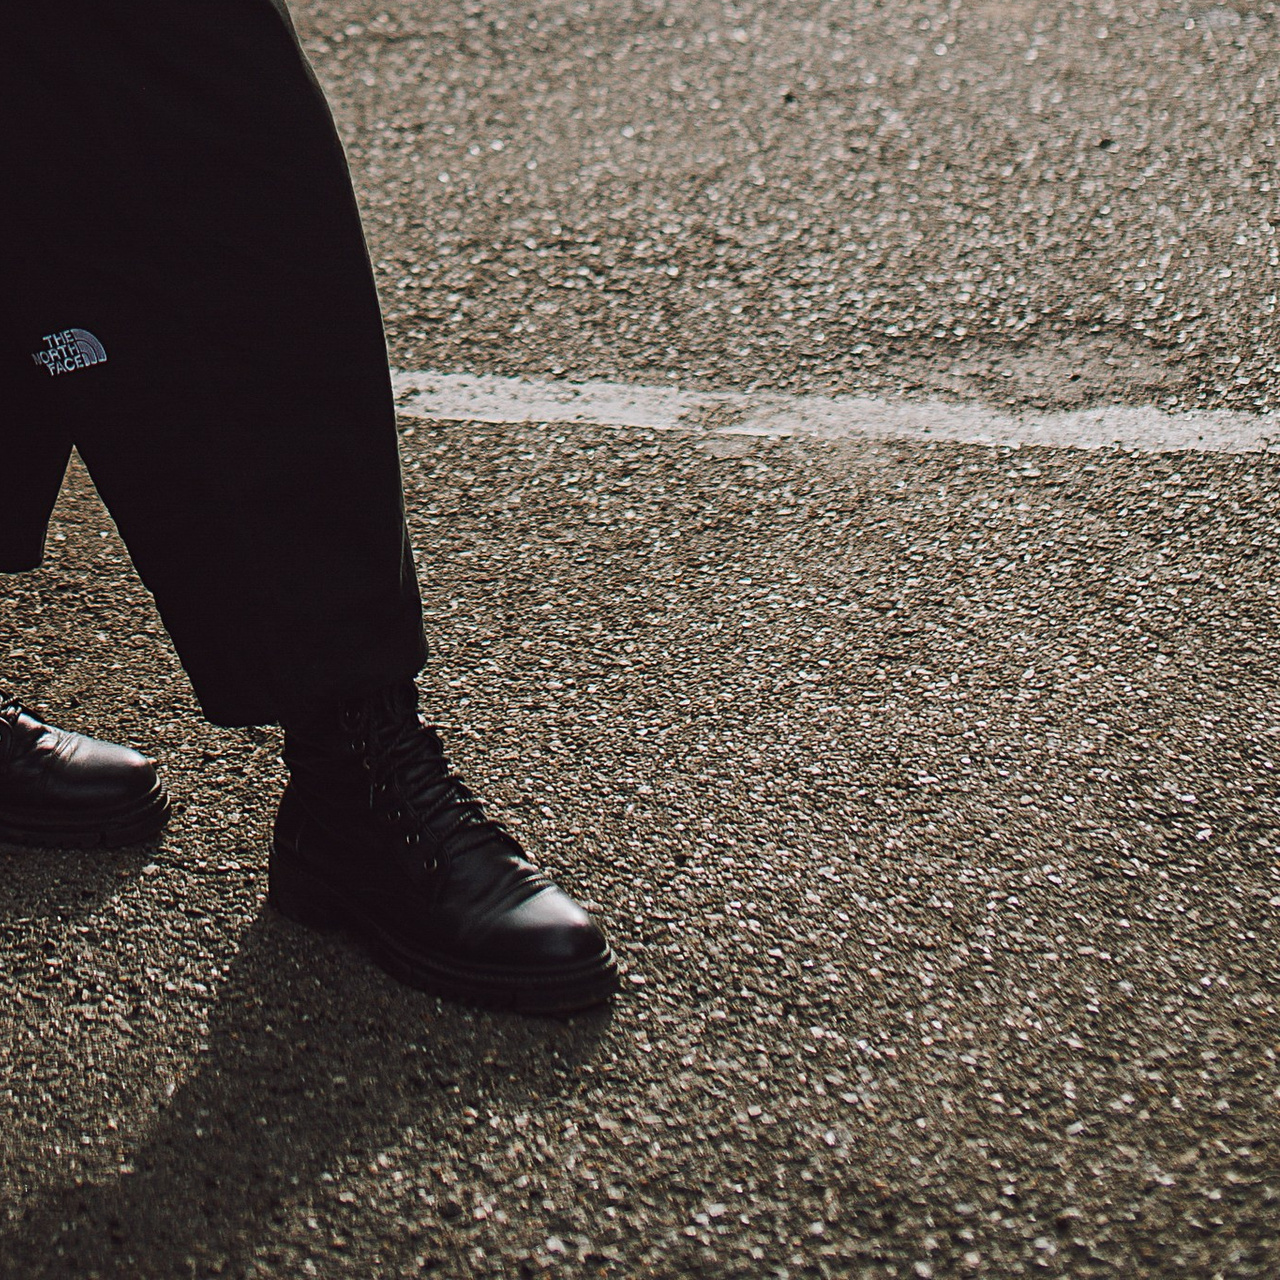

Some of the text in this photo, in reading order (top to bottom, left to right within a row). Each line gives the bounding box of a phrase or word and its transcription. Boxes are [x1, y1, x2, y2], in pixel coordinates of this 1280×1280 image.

[42, 330, 75, 348] THE
[31, 343, 80, 366] NORTH
[46, 354, 84, 376] FACE
